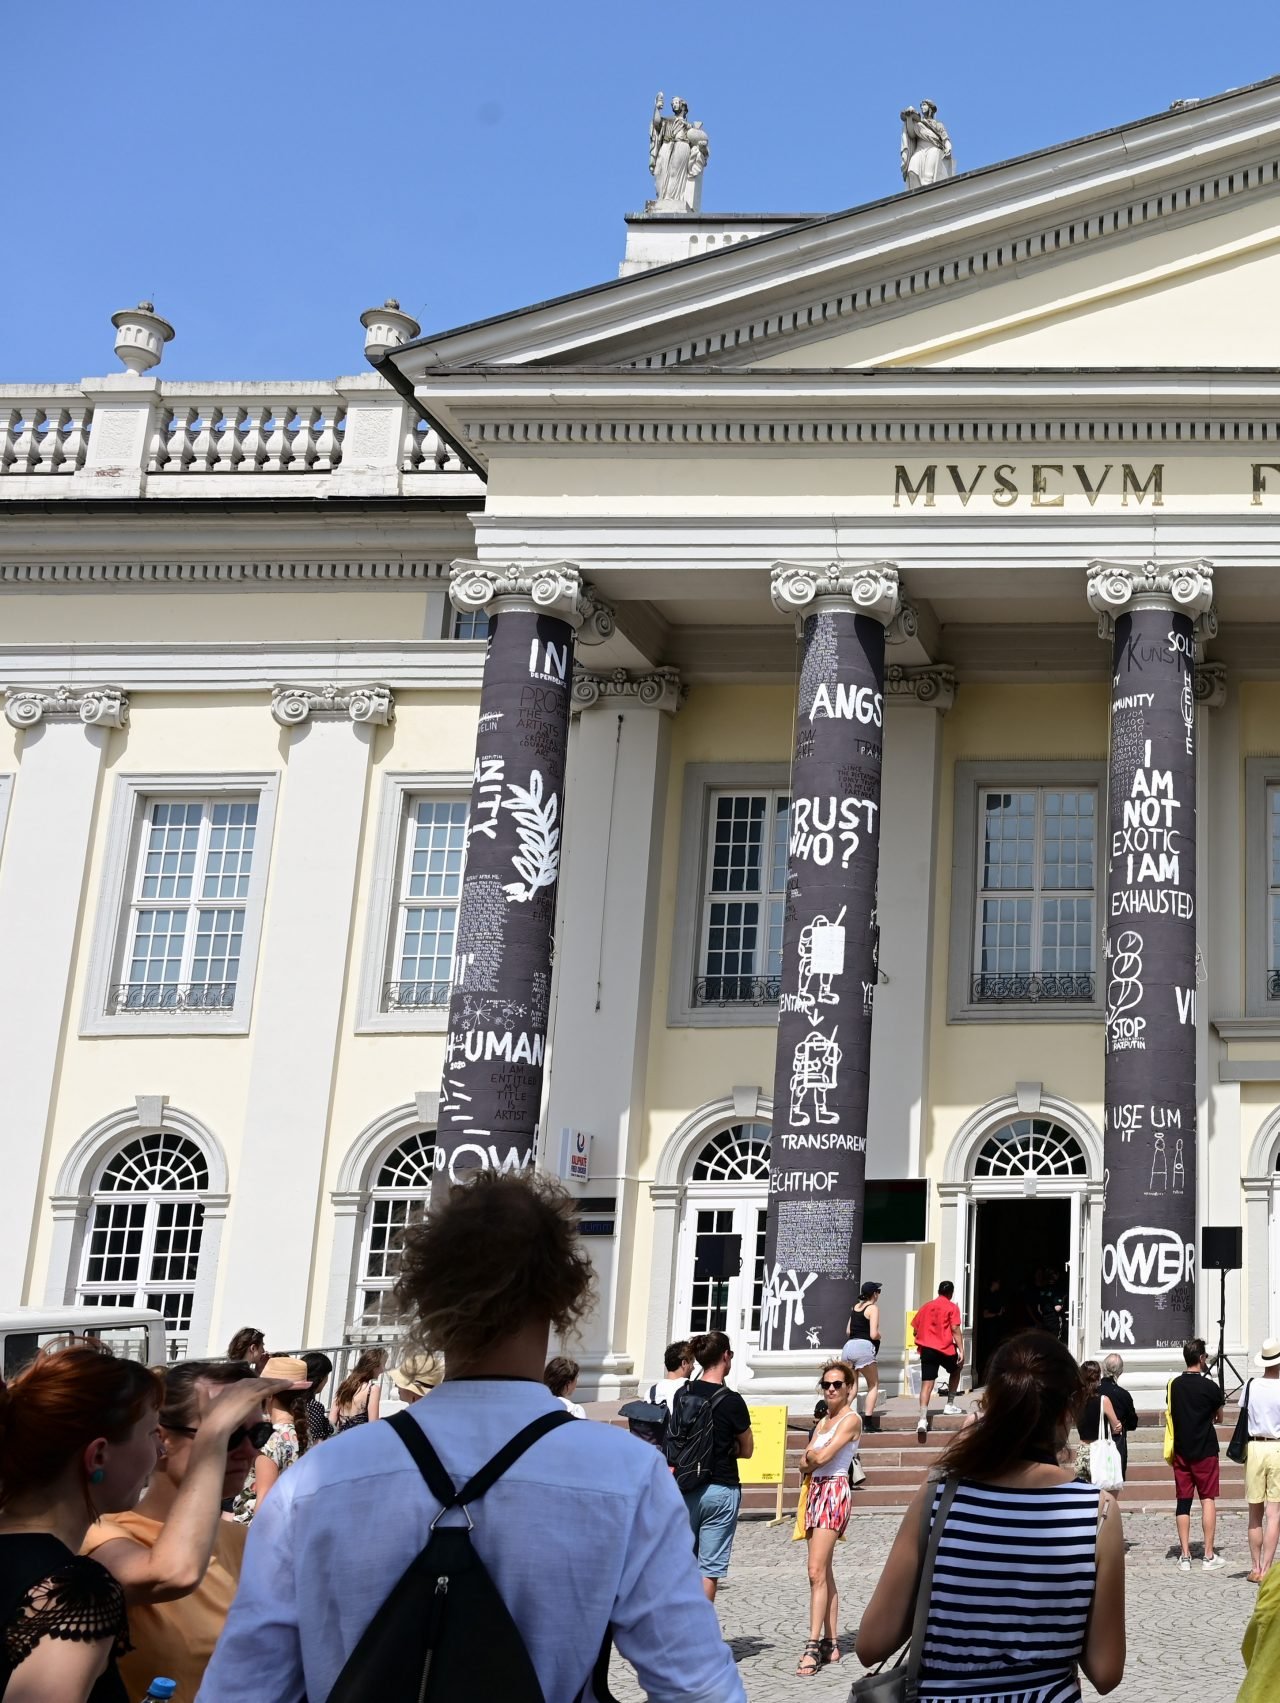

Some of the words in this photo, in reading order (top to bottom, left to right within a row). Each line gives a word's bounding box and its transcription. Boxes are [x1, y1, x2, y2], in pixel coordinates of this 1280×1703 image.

[894, 464, 1164, 507] MVSEVM
[1131, 768, 1174, 799] AM
[1123, 797, 1181, 829] NOT
[1113, 827, 1181, 857] EXOTIC
[1137, 853, 1180, 886] AM
[1111, 889, 1194, 920] EXHAUSTED
[1112, 1016, 1146, 1039] STOP
[497, 1091, 526, 1101] TITLE
[494, 1110, 527, 1121] ARTIST
